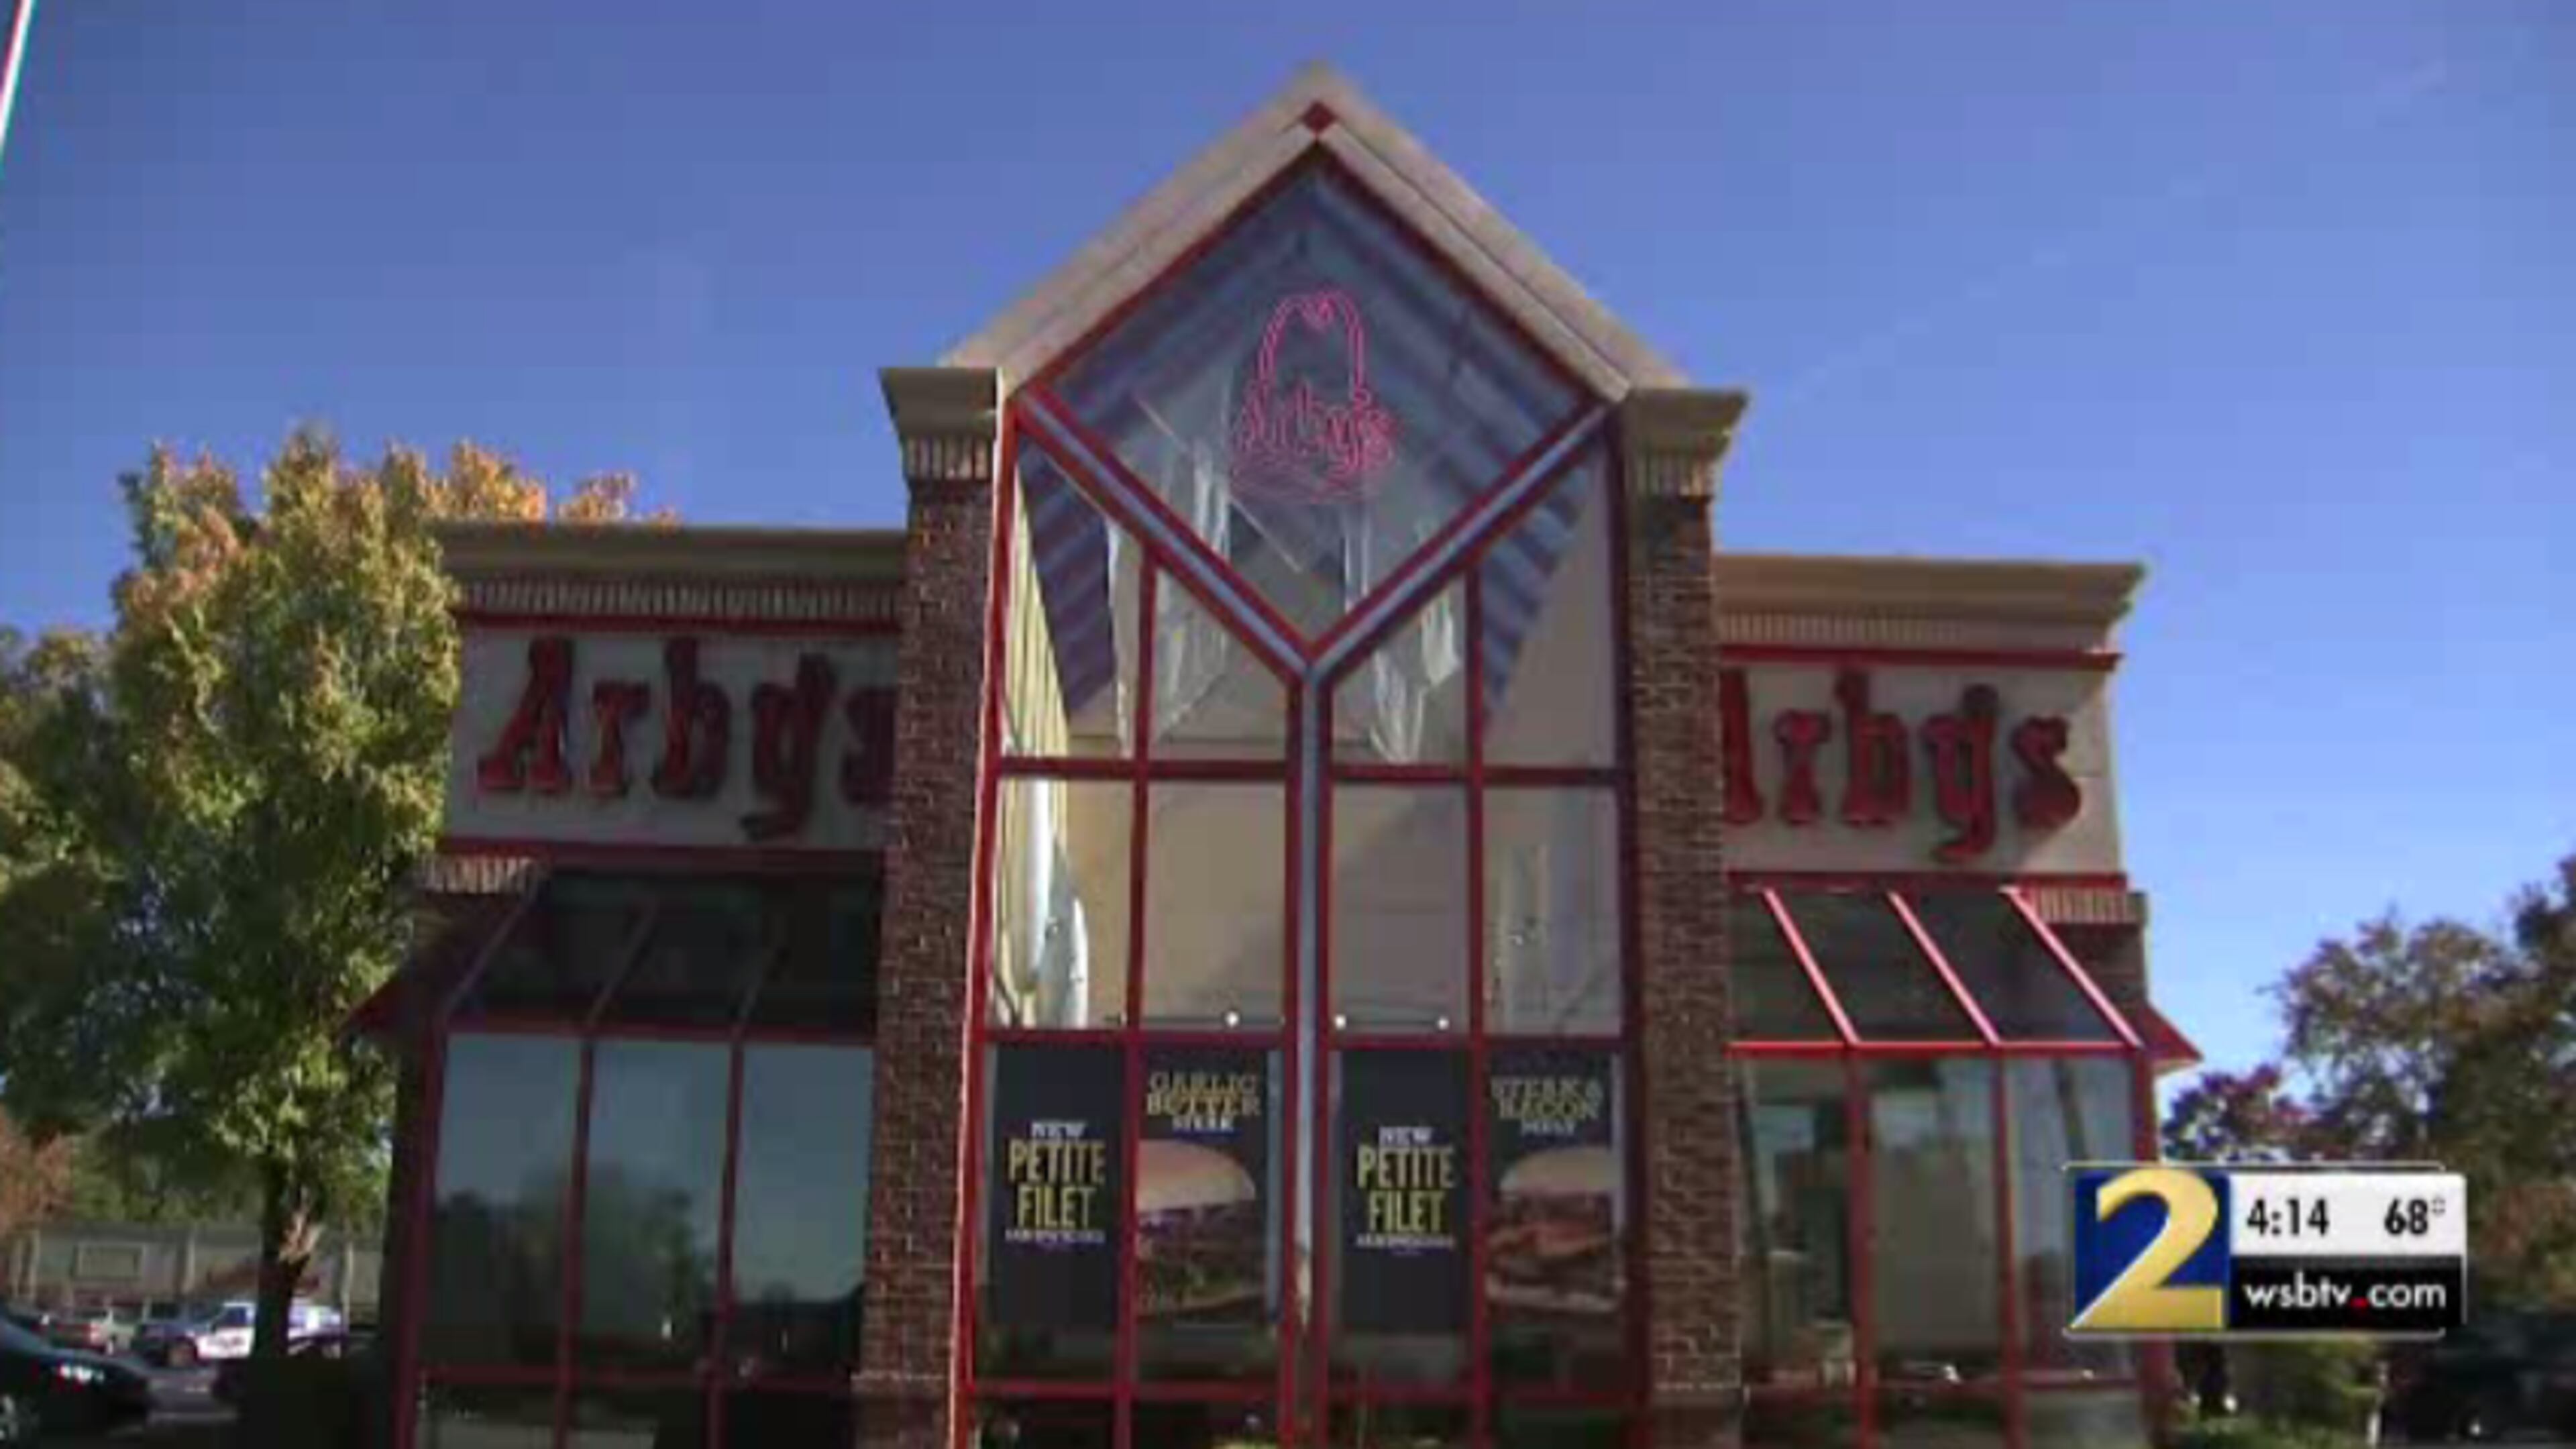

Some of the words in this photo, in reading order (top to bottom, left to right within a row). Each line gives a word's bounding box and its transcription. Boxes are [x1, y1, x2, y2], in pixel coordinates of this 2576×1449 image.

[1147, 1093, 1261, 1116] BUTTER
[1030, 1121, 1087, 1138] NEW
[1379, 1126, 1433, 1144] NEW
[1008, 1138, 1106, 1184] PETITE
[1356, 1145, 1456, 1189] PETITE
[1016, 1185, 1097, 1229] FILET
[1368, 1191, 1446, 1233] FILET
